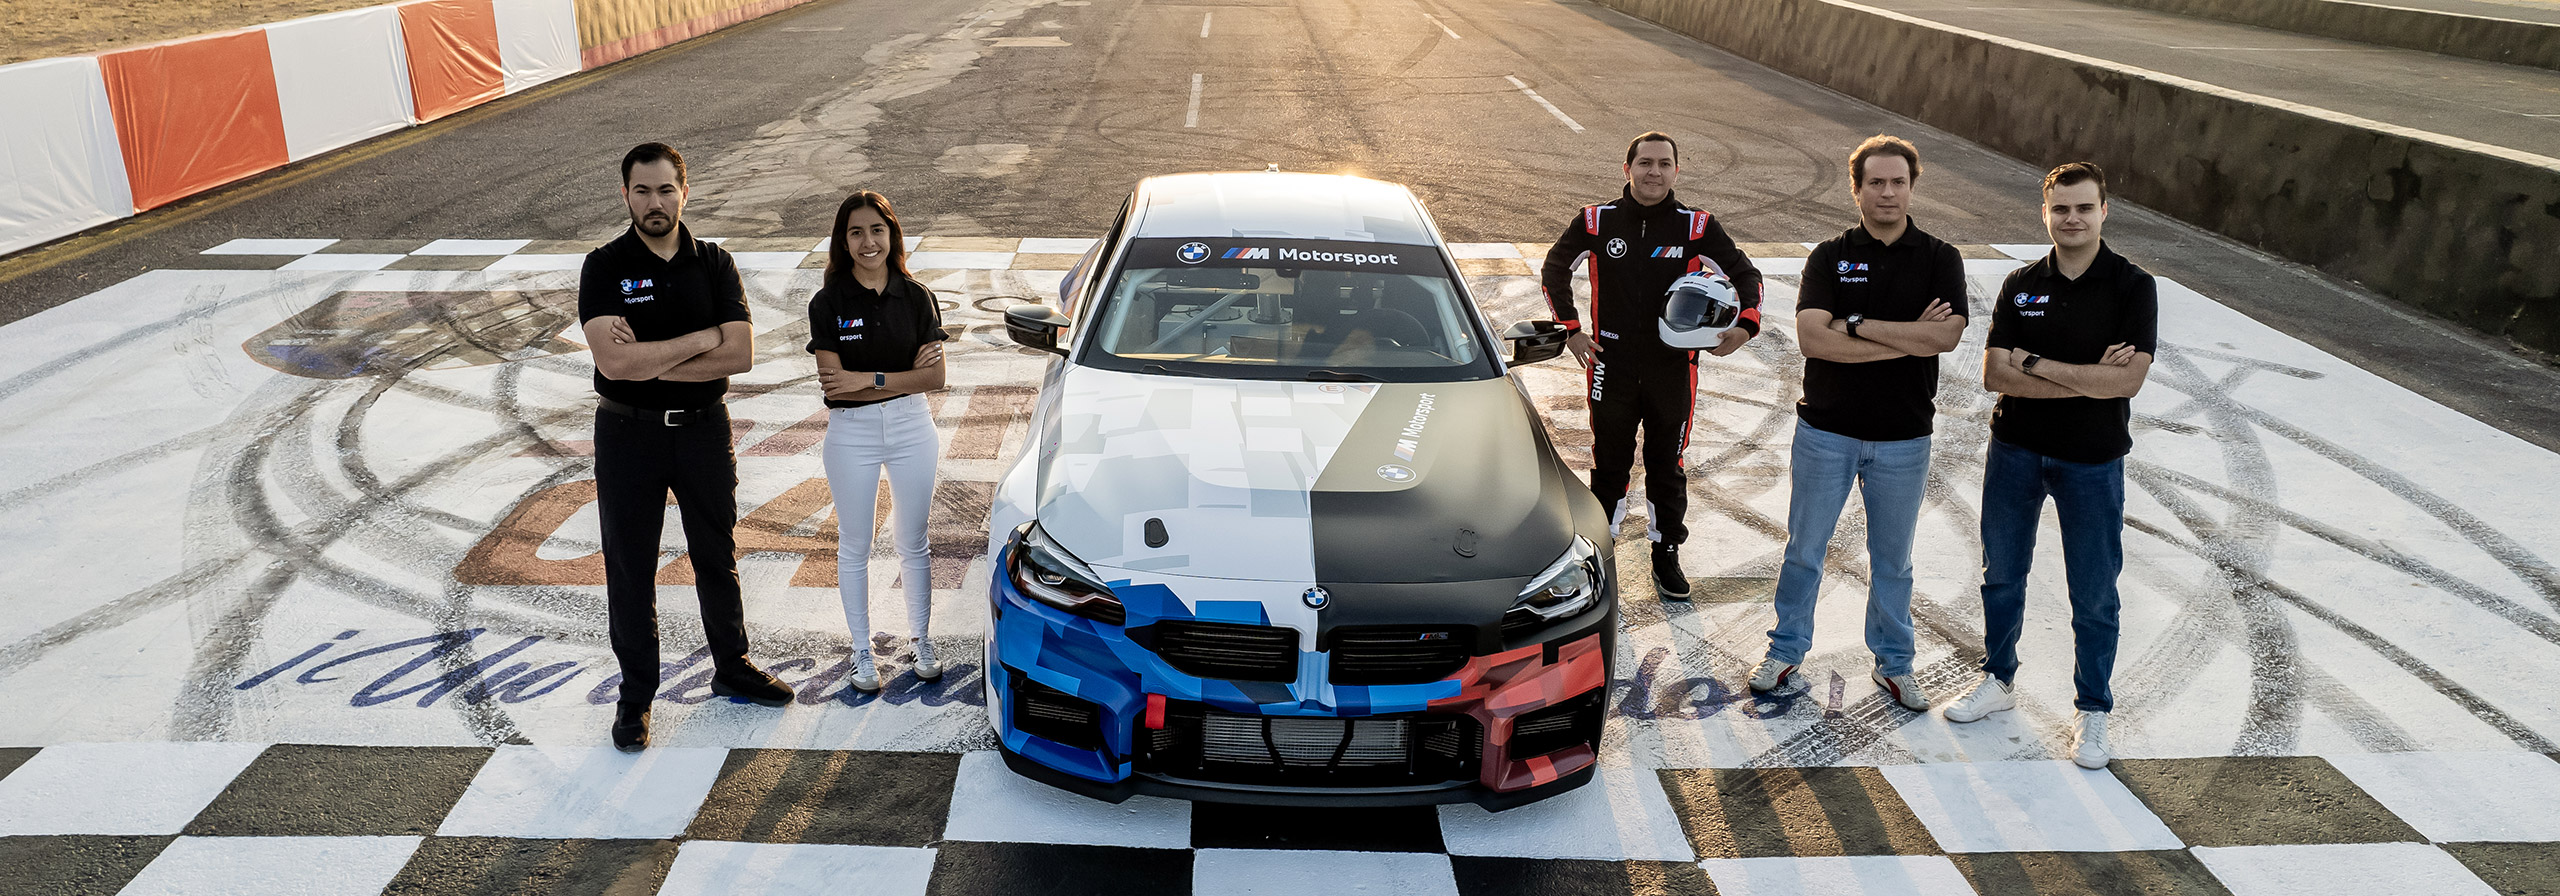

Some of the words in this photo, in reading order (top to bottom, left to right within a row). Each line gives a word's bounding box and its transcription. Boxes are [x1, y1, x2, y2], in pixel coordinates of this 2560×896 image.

[1279, 248, 1399, 266] Motorsport
[1591, 361, 1606, 401] BMW
[1401, 392, 1437, 438] Motorsport
